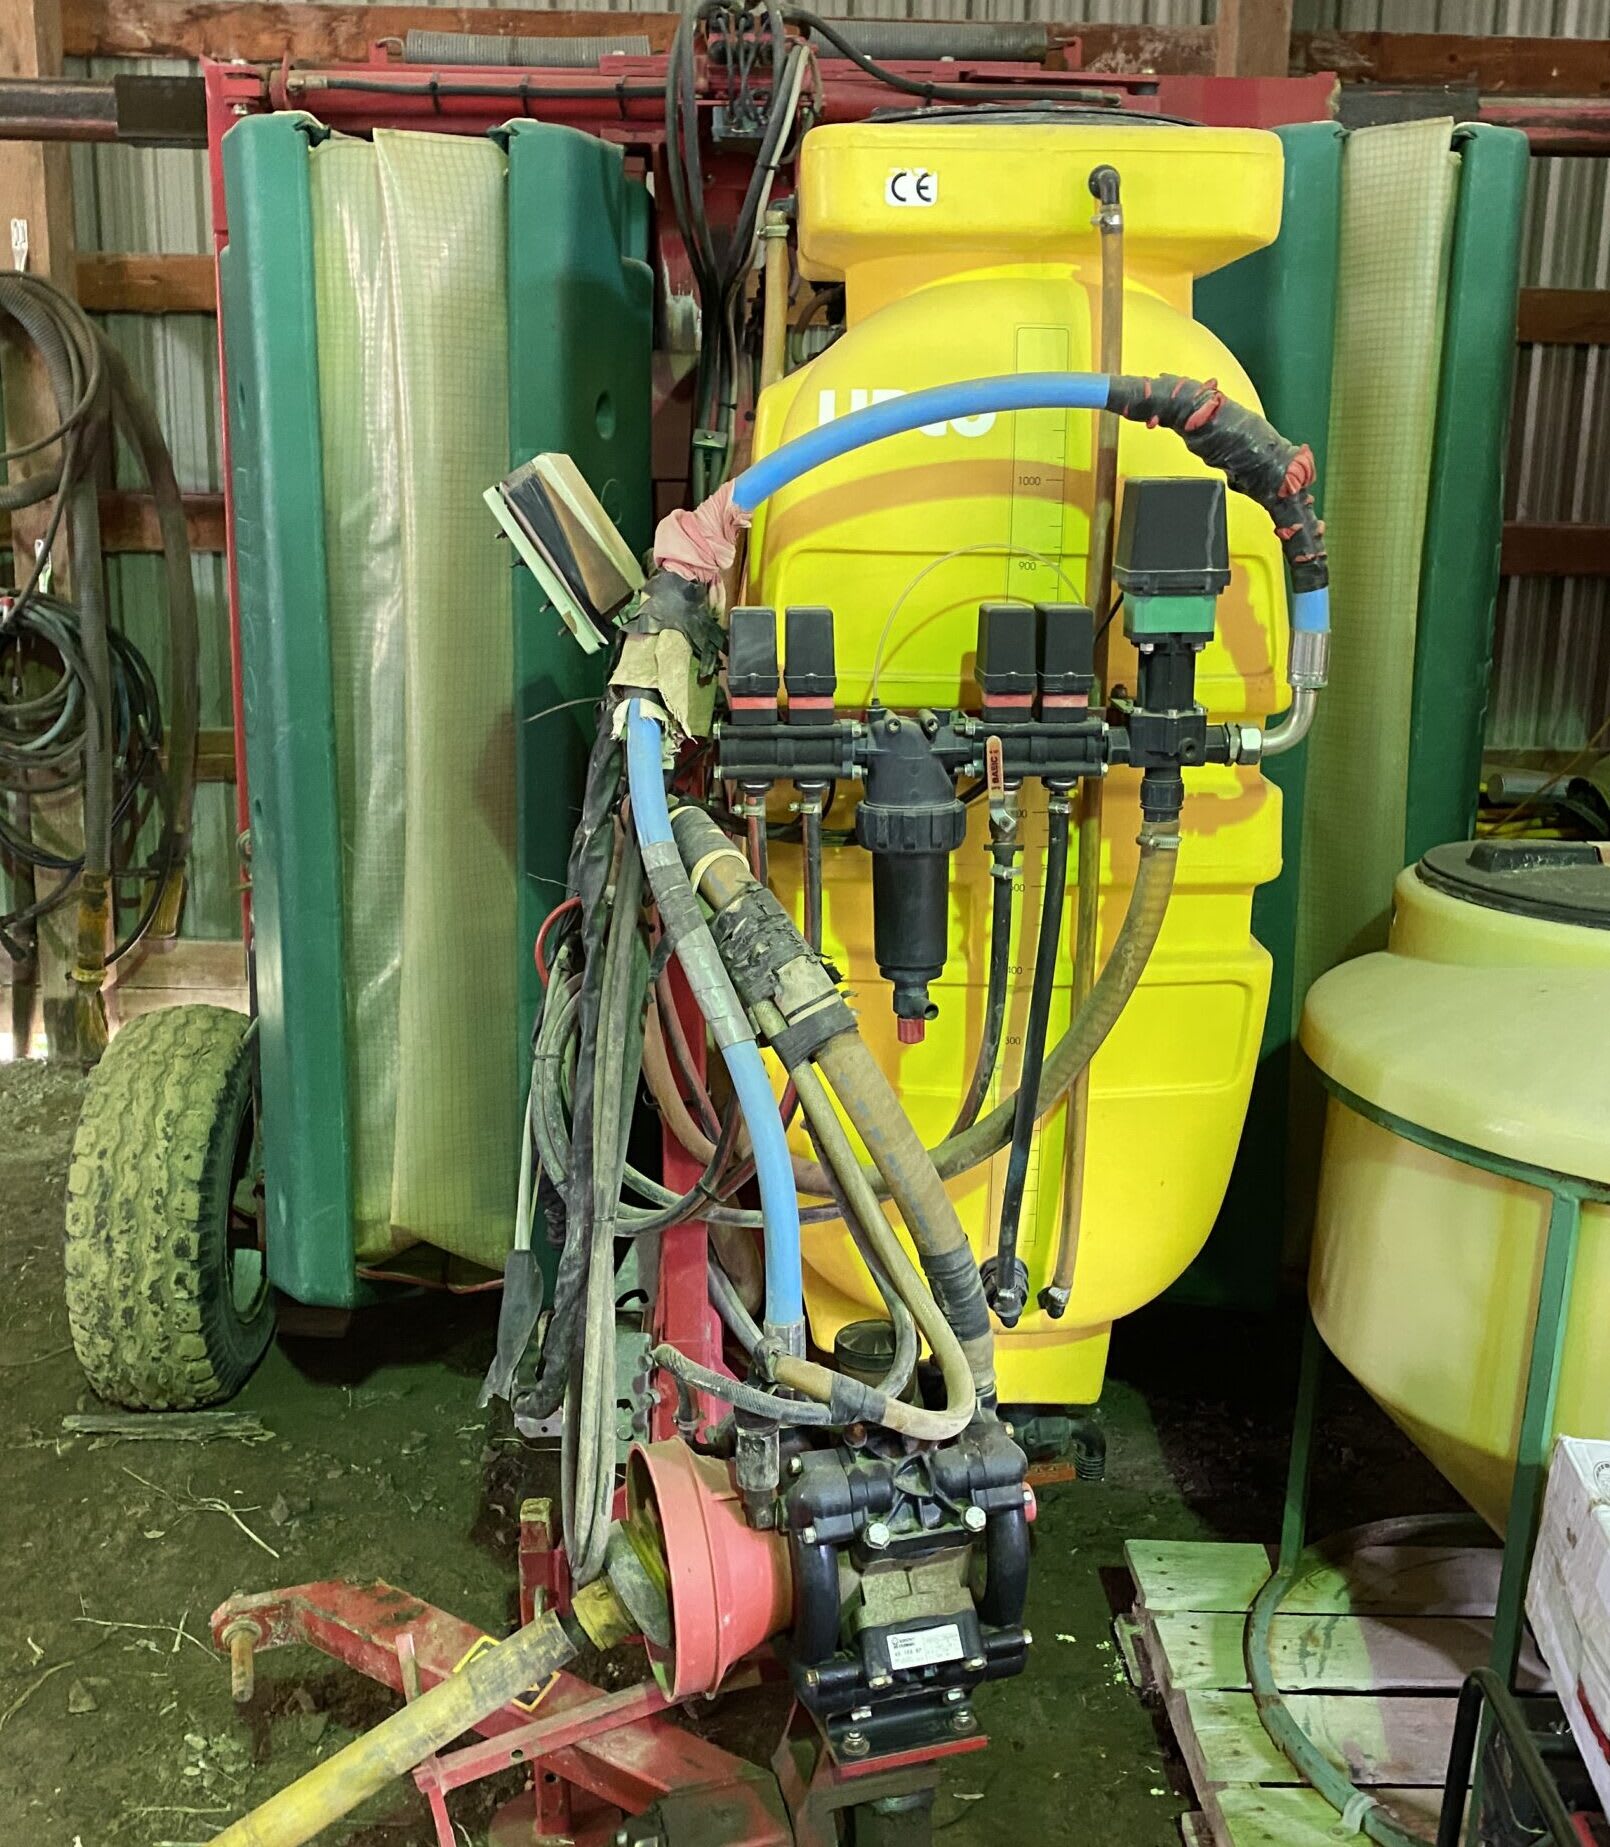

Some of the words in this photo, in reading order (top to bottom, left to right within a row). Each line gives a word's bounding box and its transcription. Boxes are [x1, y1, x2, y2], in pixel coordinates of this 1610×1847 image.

[891, 172, 932, 203] CE
[1018, 476, 1041, 486] 1000
[1018, 561, 1036, 571] 900
[990, 755, 1000, 784] BASIC
